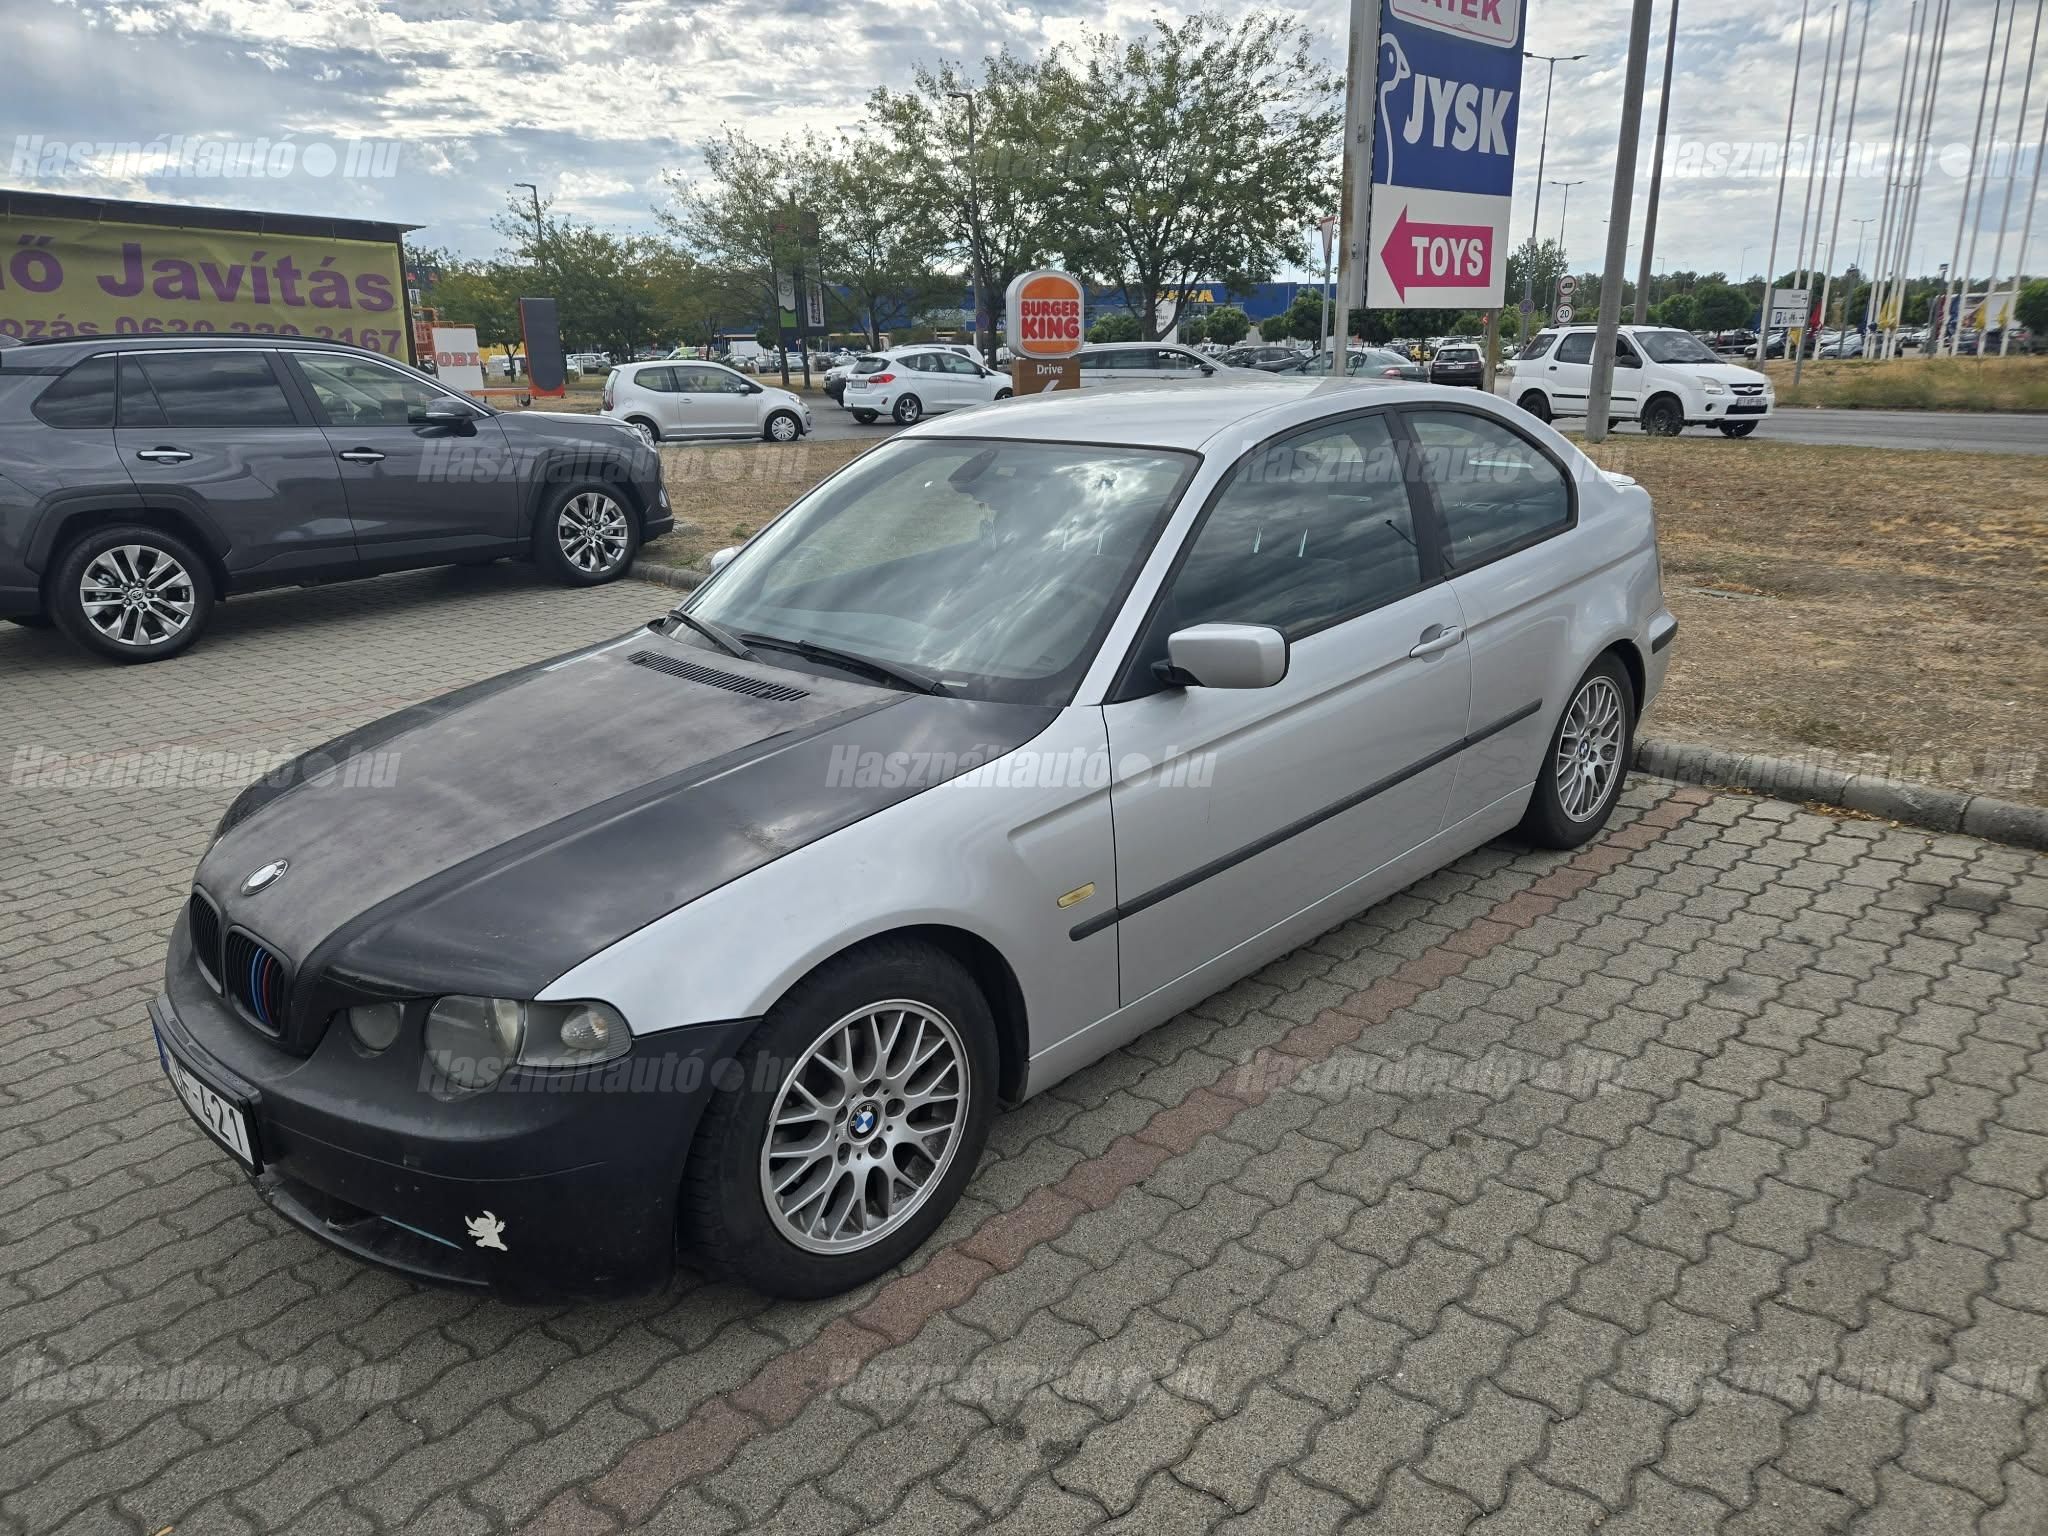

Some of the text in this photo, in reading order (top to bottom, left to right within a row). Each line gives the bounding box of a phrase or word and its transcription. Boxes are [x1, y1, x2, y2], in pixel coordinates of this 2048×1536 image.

[1403, 73, 1513, 156] JYSK
[1412, 237, 1483, 276] TOYS
[0, 234, 394, 312] ő Javítás
[1021, 301, 1079, 316] BURGER
[1560, 309, 1569, 318] 20
[1021, 317, 1079, 339] KING
[437, 352, 479, 366] OBI
[1037, 364, 1063, 375] Drive
